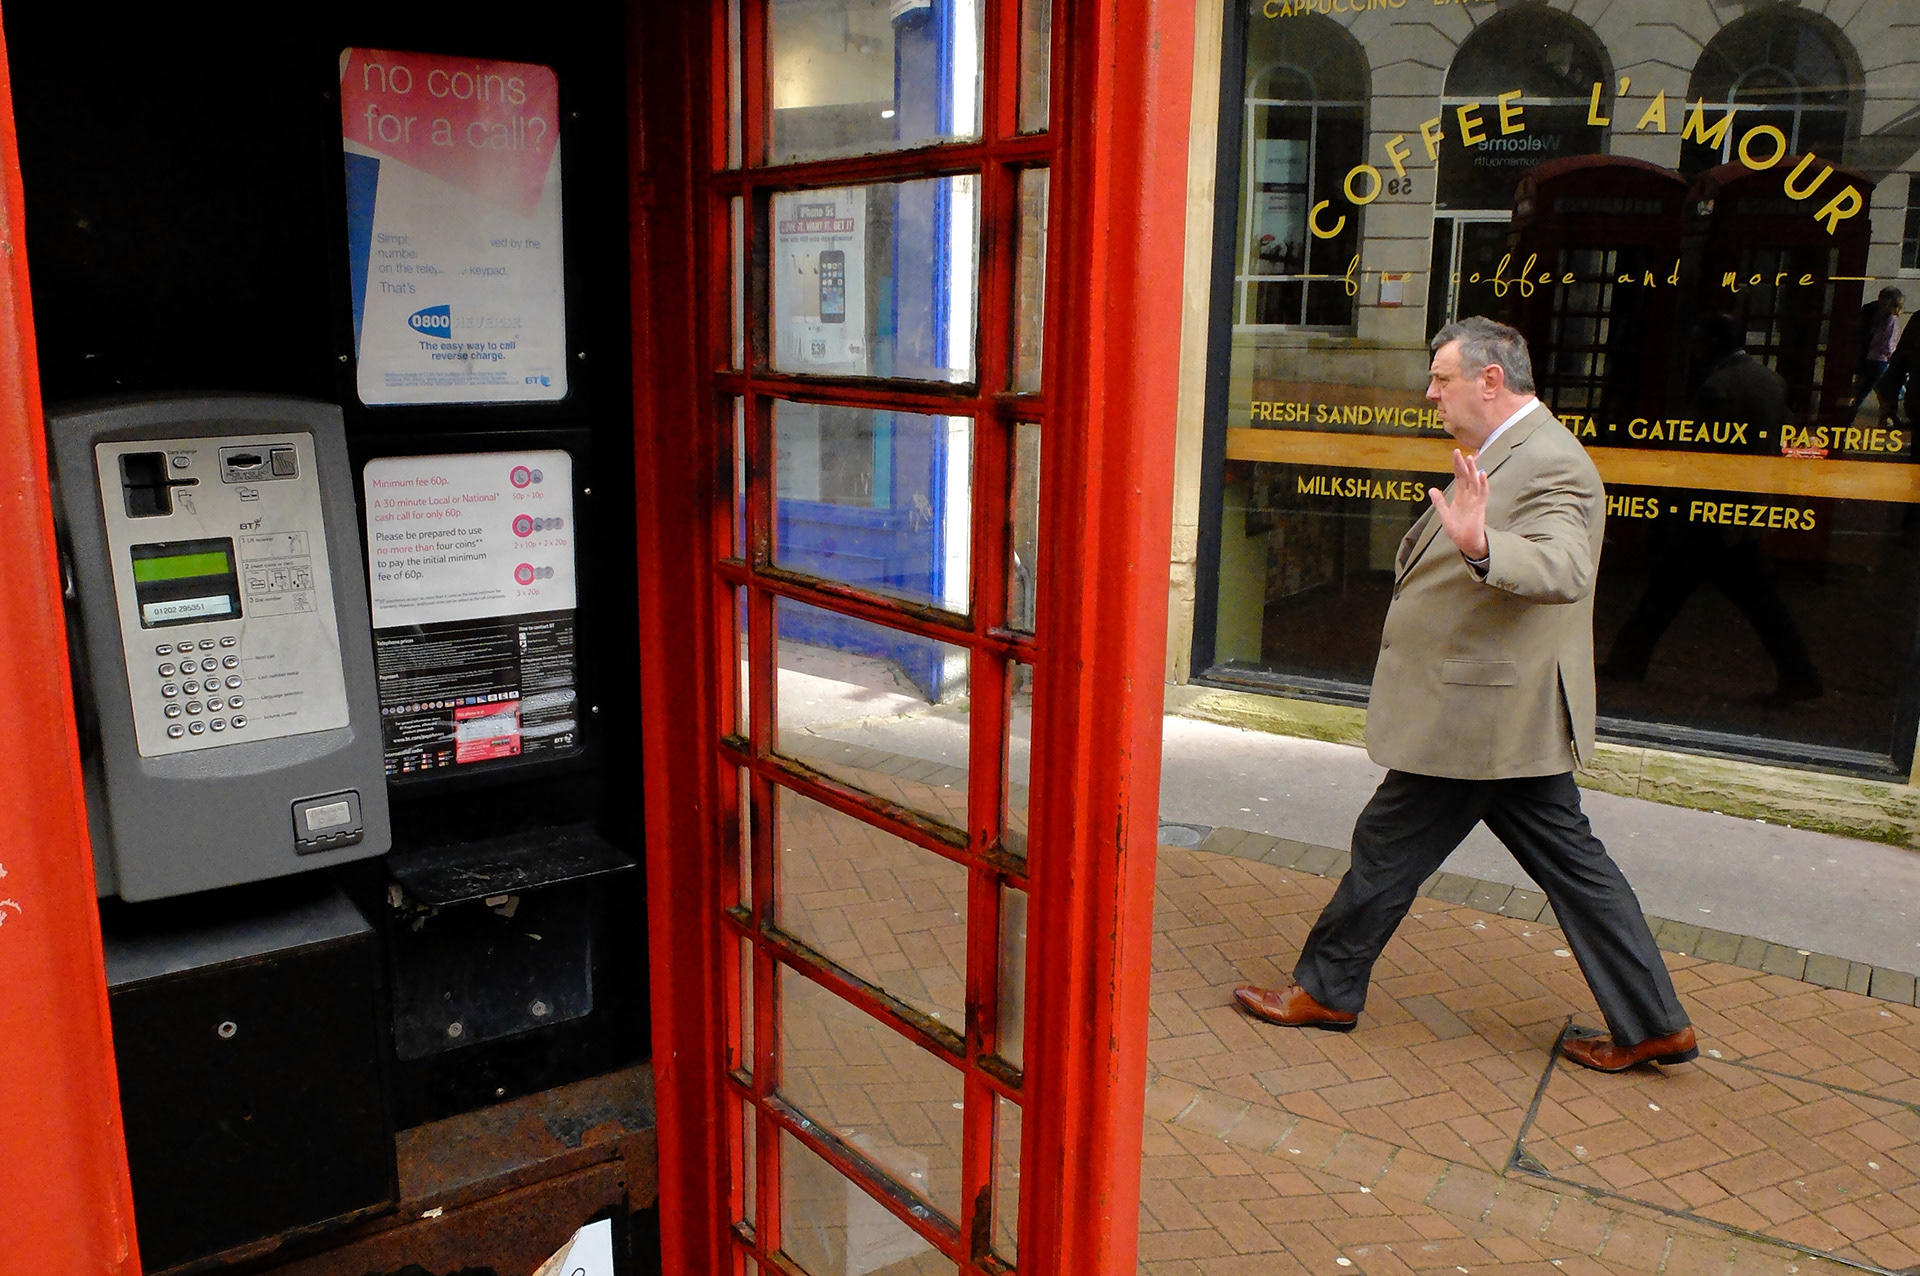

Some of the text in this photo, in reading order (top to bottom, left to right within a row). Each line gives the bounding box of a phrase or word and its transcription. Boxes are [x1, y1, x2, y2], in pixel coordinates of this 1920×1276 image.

[363, 63, 526, 104] no coins
[364, 104, 547, 152] for a call?
[1309, 77, 1863, 239] COFFEE L'AMOUR
[377, 232, 409, 246] Simpl
[525, 239, 541, 249] the
[377, 248, 418, 259] numbe
[378, 263, 394, 273] on
[396, 263, 414, 273] the
[1452, 253, 1576, 297] coffee
[1618, 259, 1681, 287] and
[1721, 271, 1815, 288] more
[379, 281, 416, 294] That's
[411, 315, 450, 328] 0800
[419, 341, 516, 353] The easy way to call
[431, 352, 506, 362] reverse charge.
[524, 376, 540, 385] BT
[1250, 401, 1311, 423] FRESH
[1316, 404, 1445, 430] SANDWICHE
[1628, 418, 1748, 445] GATEAUX
[1780, 424, 1904, 452] PASTRIES
[373, 476, 449, 488] Minimum fee 60p.
[532, 491, 544, 500] 10p
[374, 499, 381, 509] A
[384, 498, 395, 508] 30
[397, 498, 427, 507] minute
[429, 496, 450, 505] Local
[1297, 475, 1425, 502] MILKSHAKES
[1689, 501, 1816, 530] FREEZERS
[374, 512, 395, 522] cash
[396, 511, 411, 521] call
[412, 510, 424, 520] for
[426, 510, 444, 520] only
[240, 522, 254, 530] BT
[375, 527, 483, 541] Please be prepared to use
[377, 547, 388, 555] no
[390, 546, 413, 554] more
[415, 544, 434, 553] than
[436, 541, 453, 551] four
[377, 552, 487, 569] to pay the initial minimum
[378, 569, 424, 581] fee of 60p.
[154, 606, 176, 615] 01202
